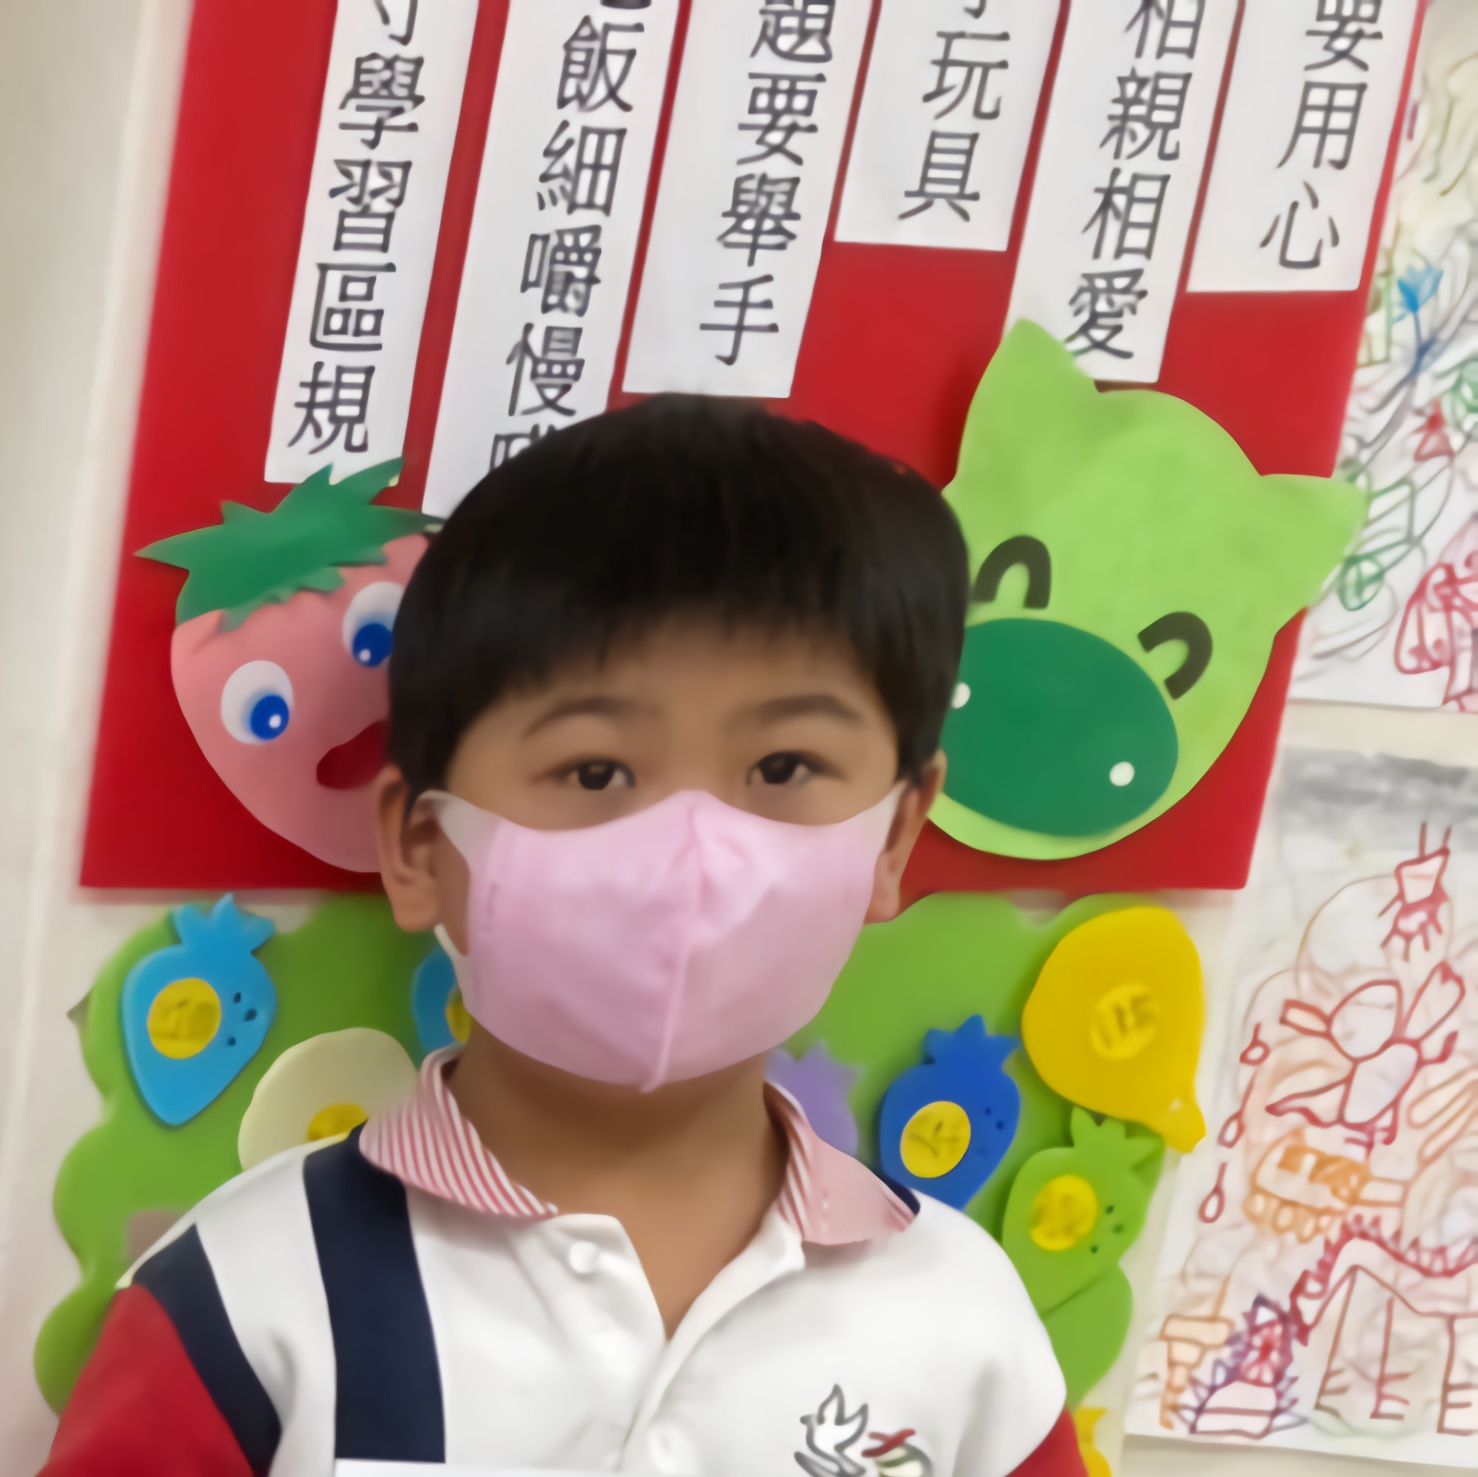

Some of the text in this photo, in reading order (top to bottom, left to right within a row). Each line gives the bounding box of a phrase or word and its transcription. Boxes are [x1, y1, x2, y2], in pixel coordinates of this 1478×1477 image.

[490, 0, 651, 472] 飯細嚼慢
[898, 0, 1010, 222] 玩具
[1066, 0, 1205, 360] 相親相愛
[1260, 0, 1384, 269] 要用心
